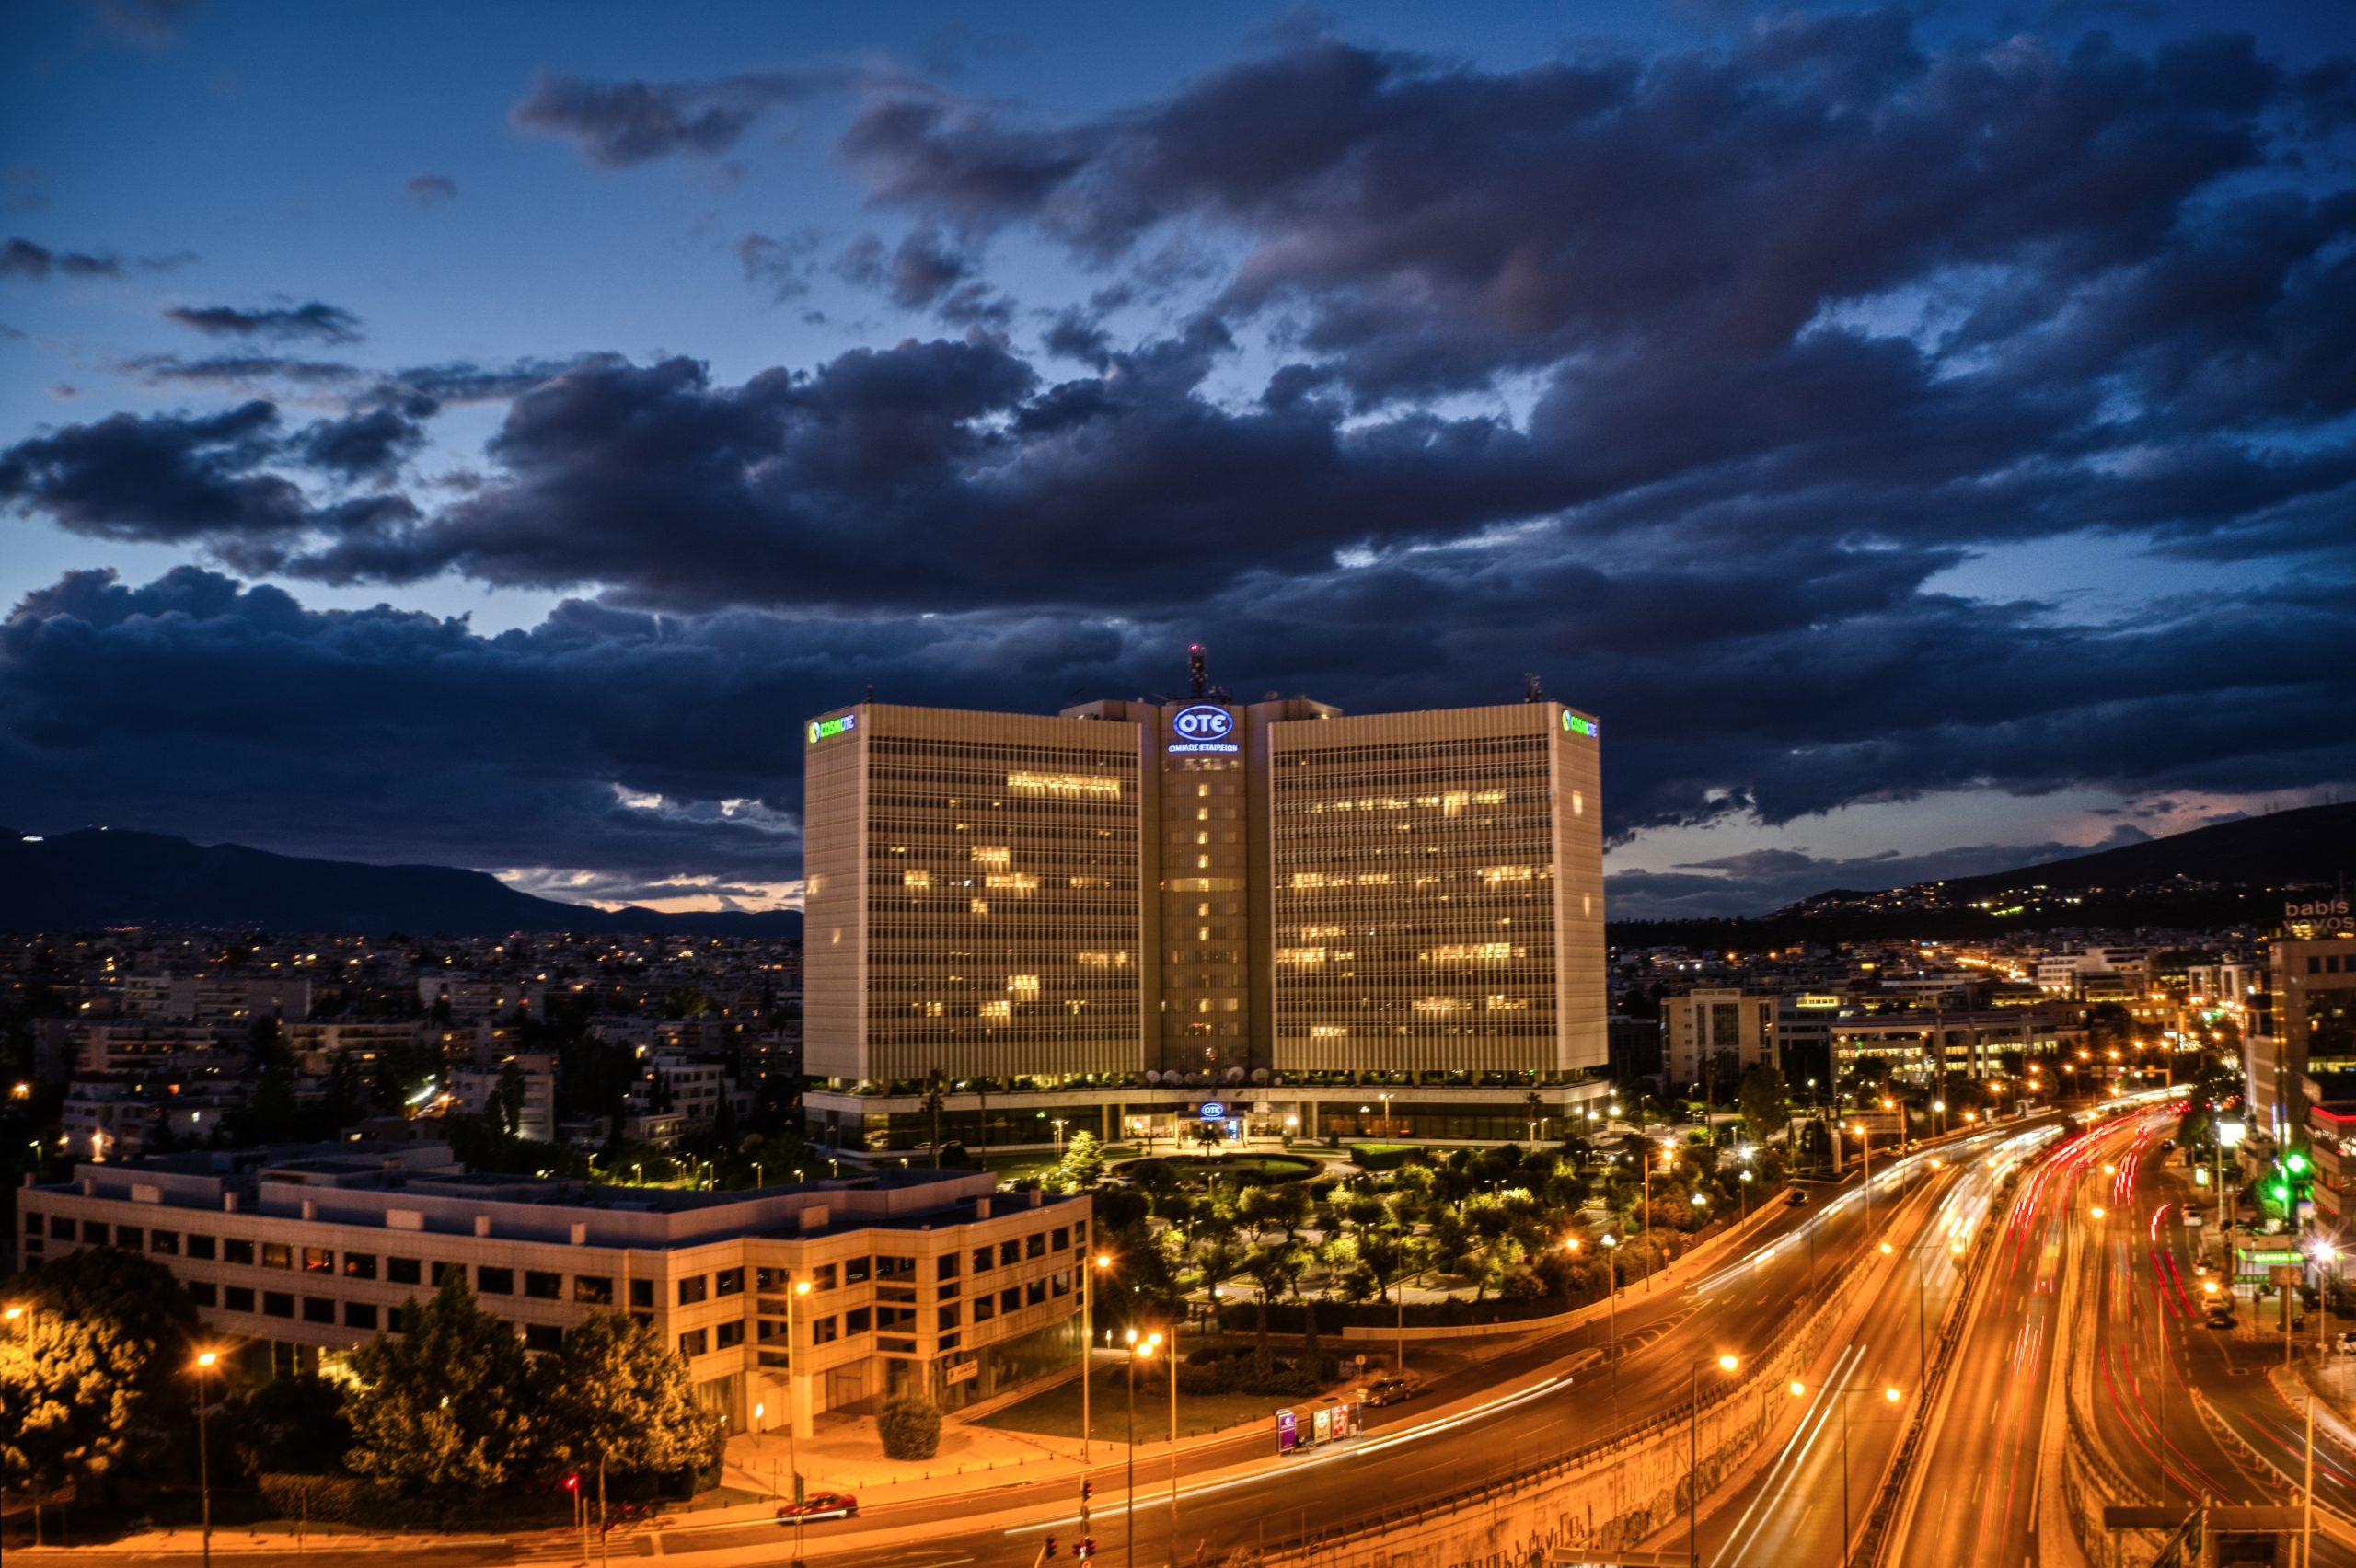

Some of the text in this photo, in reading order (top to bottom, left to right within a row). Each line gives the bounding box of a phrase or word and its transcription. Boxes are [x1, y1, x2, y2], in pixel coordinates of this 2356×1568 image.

[1179, 714, 1227, 732] OTE
[2284, 900, 2350, 917] babis
[1204, 1106, 1220, 1114] OTE
